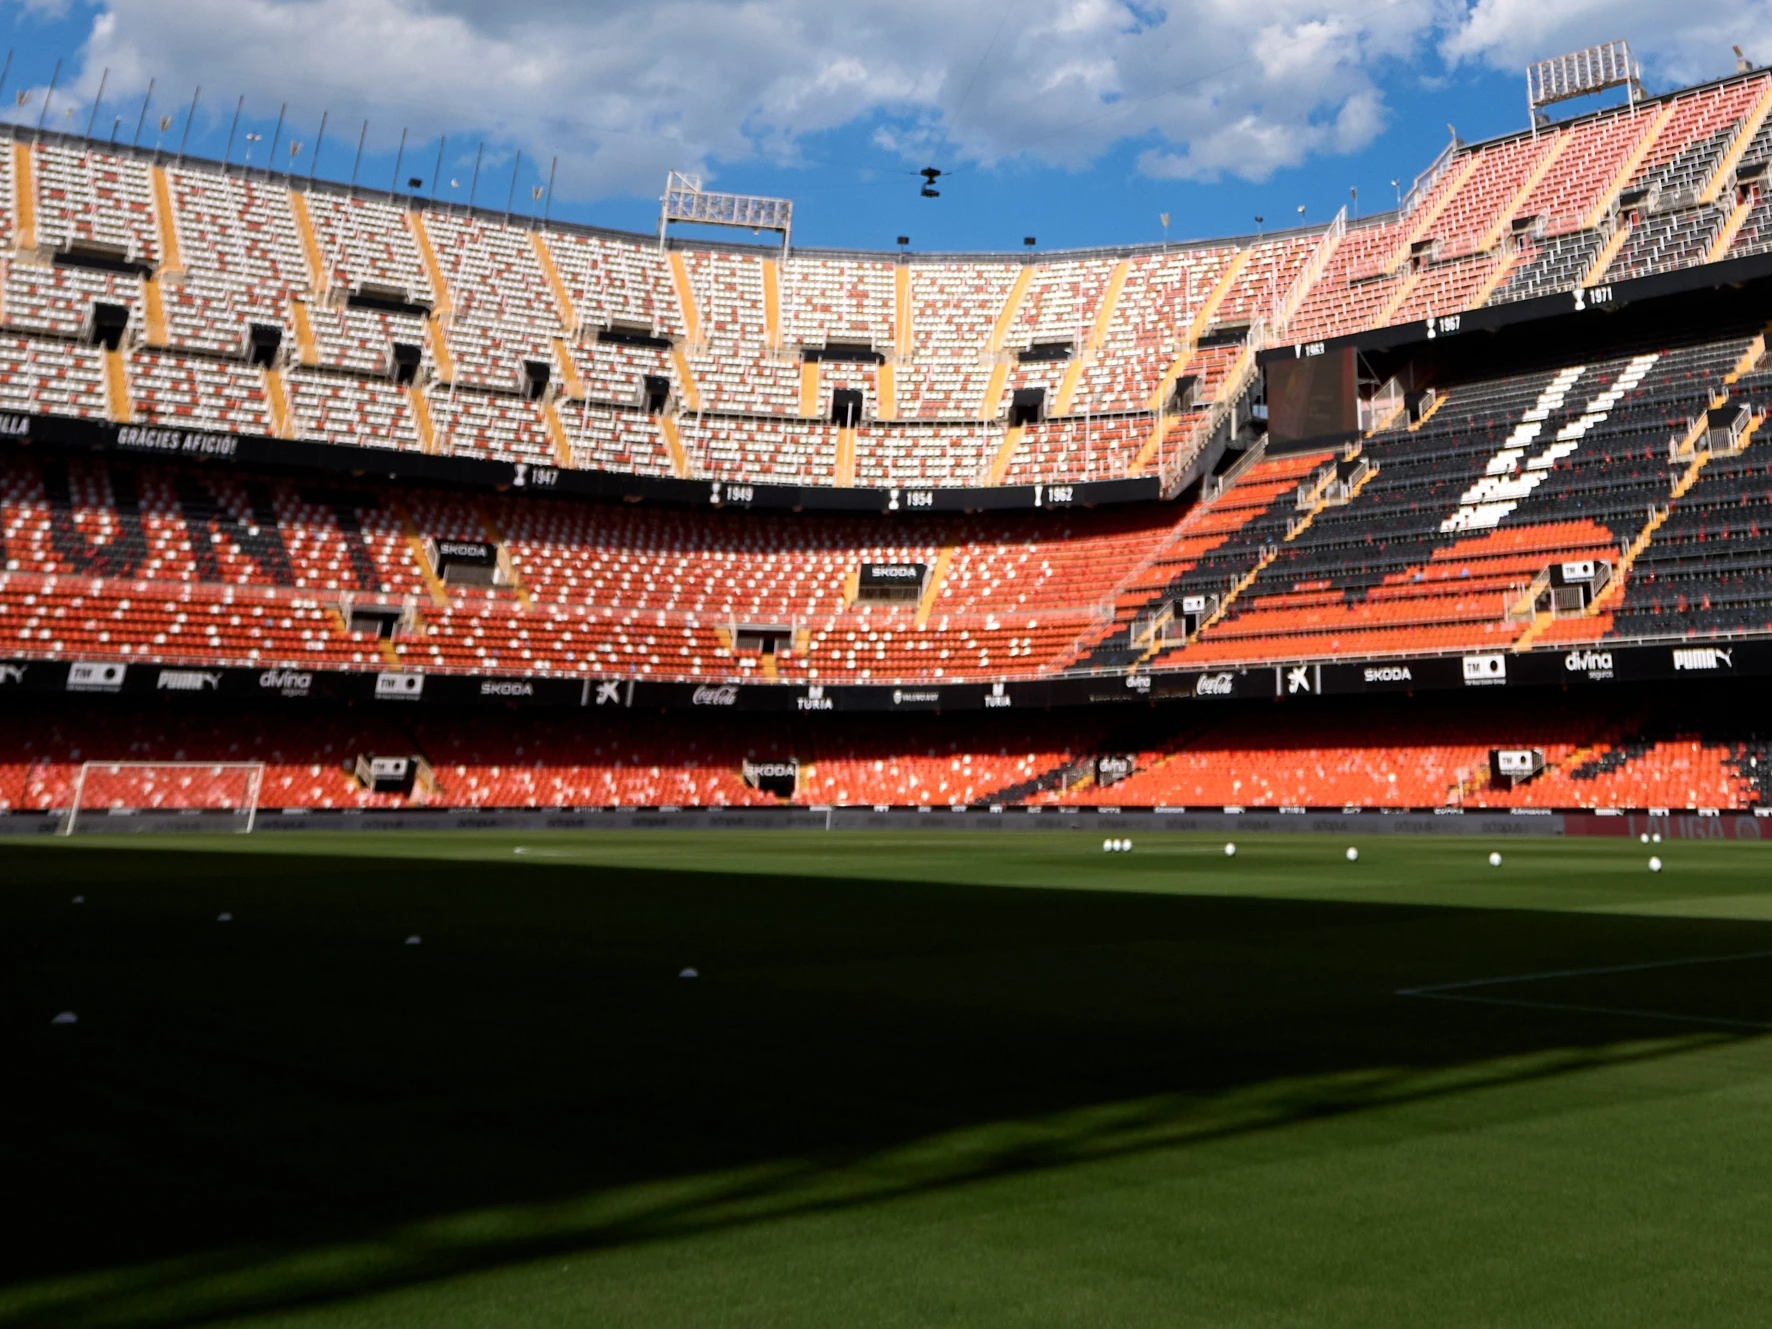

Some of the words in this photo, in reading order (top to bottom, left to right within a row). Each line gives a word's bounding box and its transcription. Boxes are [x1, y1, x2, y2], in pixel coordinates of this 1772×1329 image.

[1589, 286, 1613, 304] 1971
[1438, 315, 1460, 333] 1967
[531, 468, 558, 486] 1947
[726, 486, 754, 502] 1949
[906, 491, 932, 507] 1954
[1048, 485, 1073, 503] 1962
[1565, 650, 1613, 671] divina
[1673, 647, 1716, 670] PUMA
[1467, 662, 1481, 674] TM
[259, 667, 312, 689] divina
[797, 698, 833, 710] TURIA
